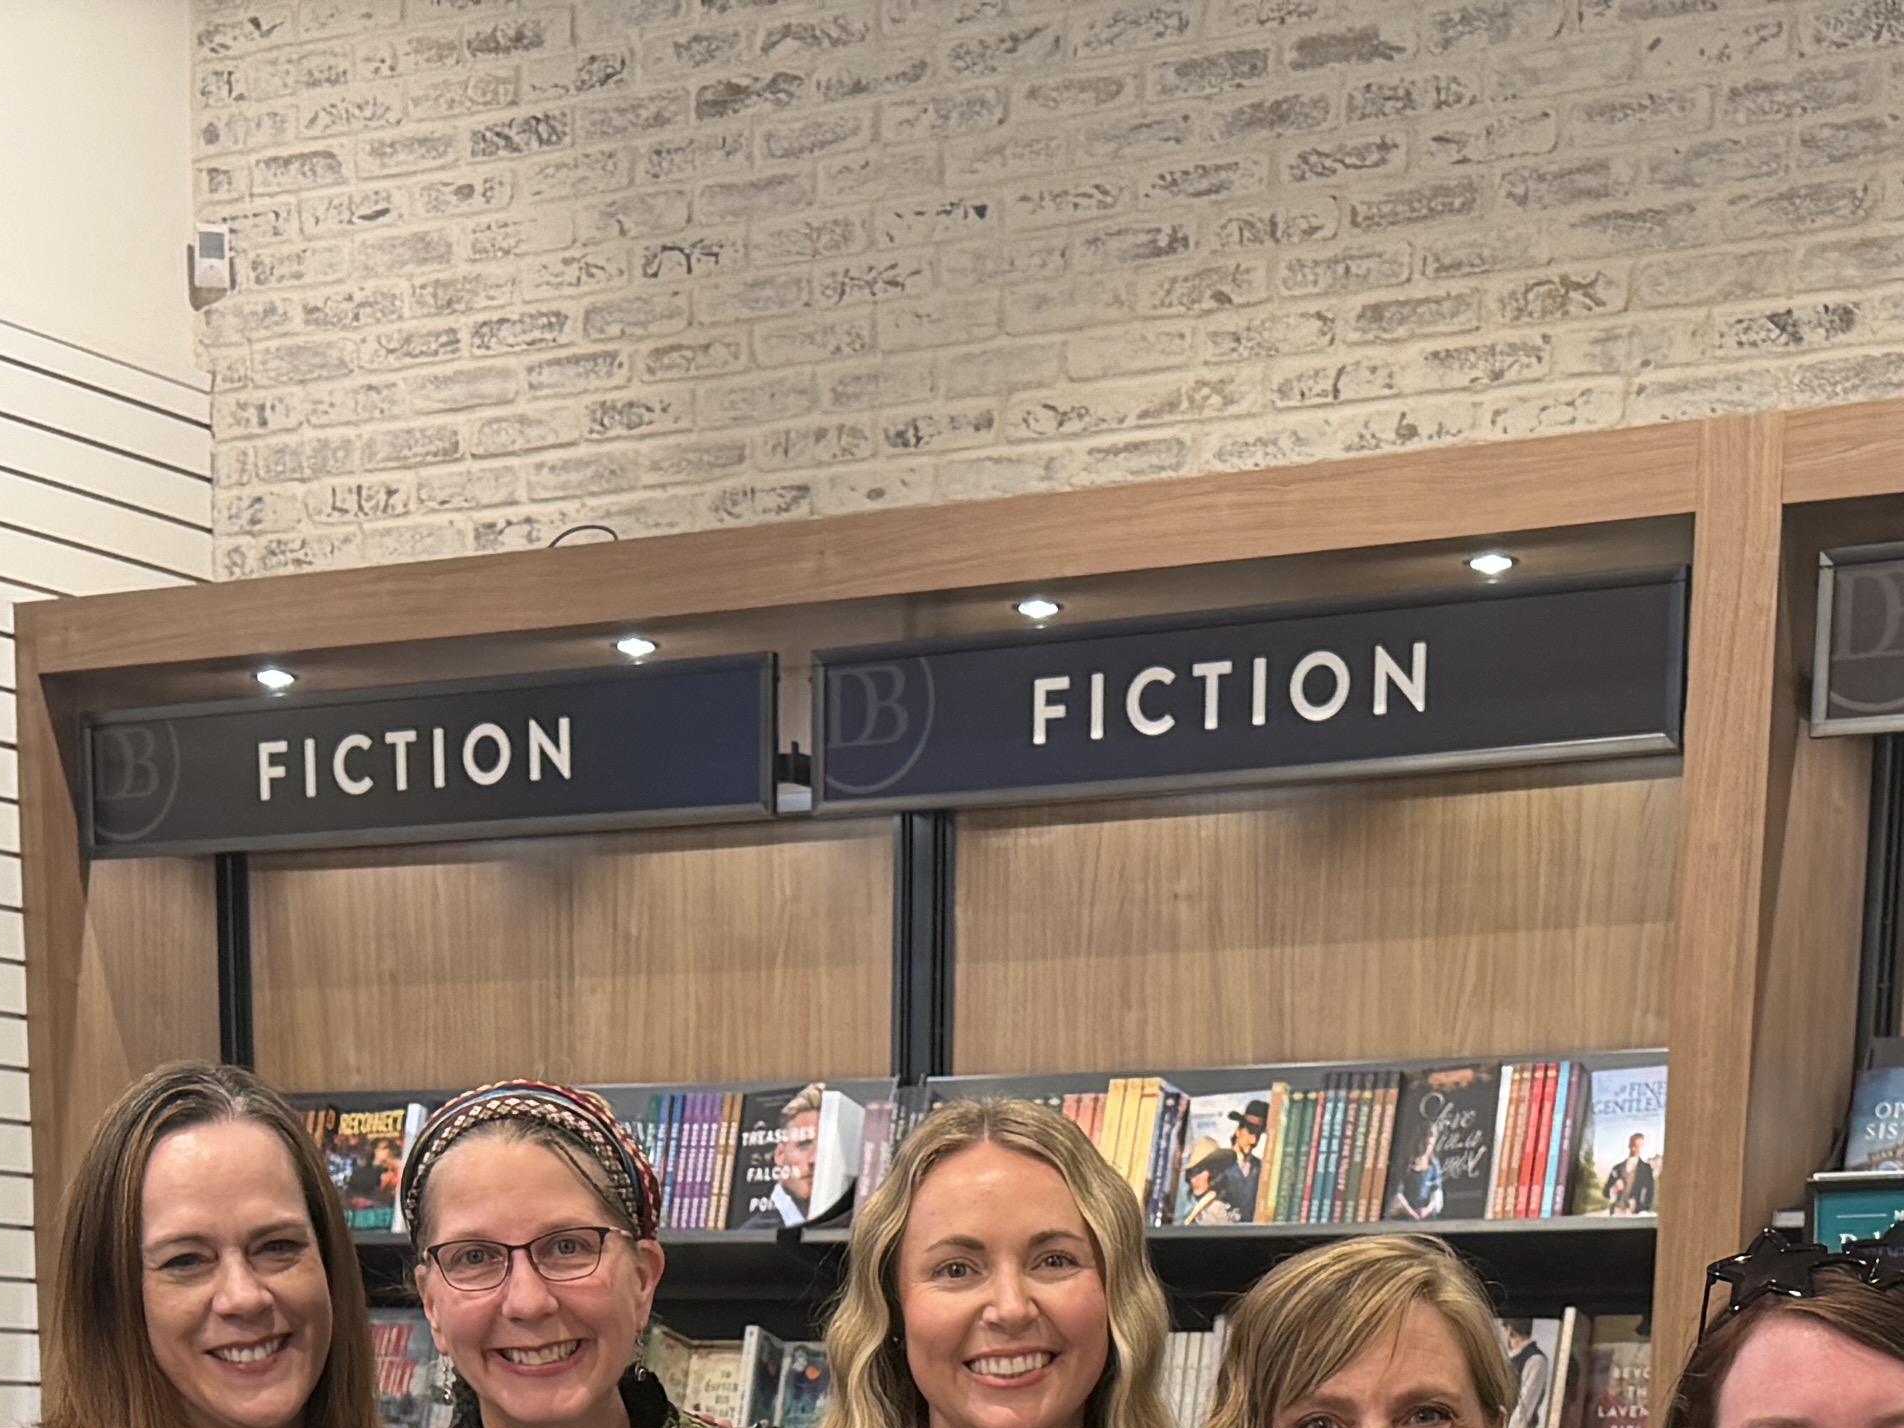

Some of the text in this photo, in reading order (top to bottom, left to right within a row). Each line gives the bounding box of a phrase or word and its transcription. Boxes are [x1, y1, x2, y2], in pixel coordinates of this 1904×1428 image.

[1030, 640, 1427, 745] FICTION
[257, 715, 572, 803] FICTION
[742, 1125, 816, 1147] TREASURES
[746, 1165, 800, 1182] FALCON
[1614, 1367, 1649, 1379] BEYO
[1628, 1385, 1648, 1398] TH
[1598, 1406, 1649, 1418] LAVEN
